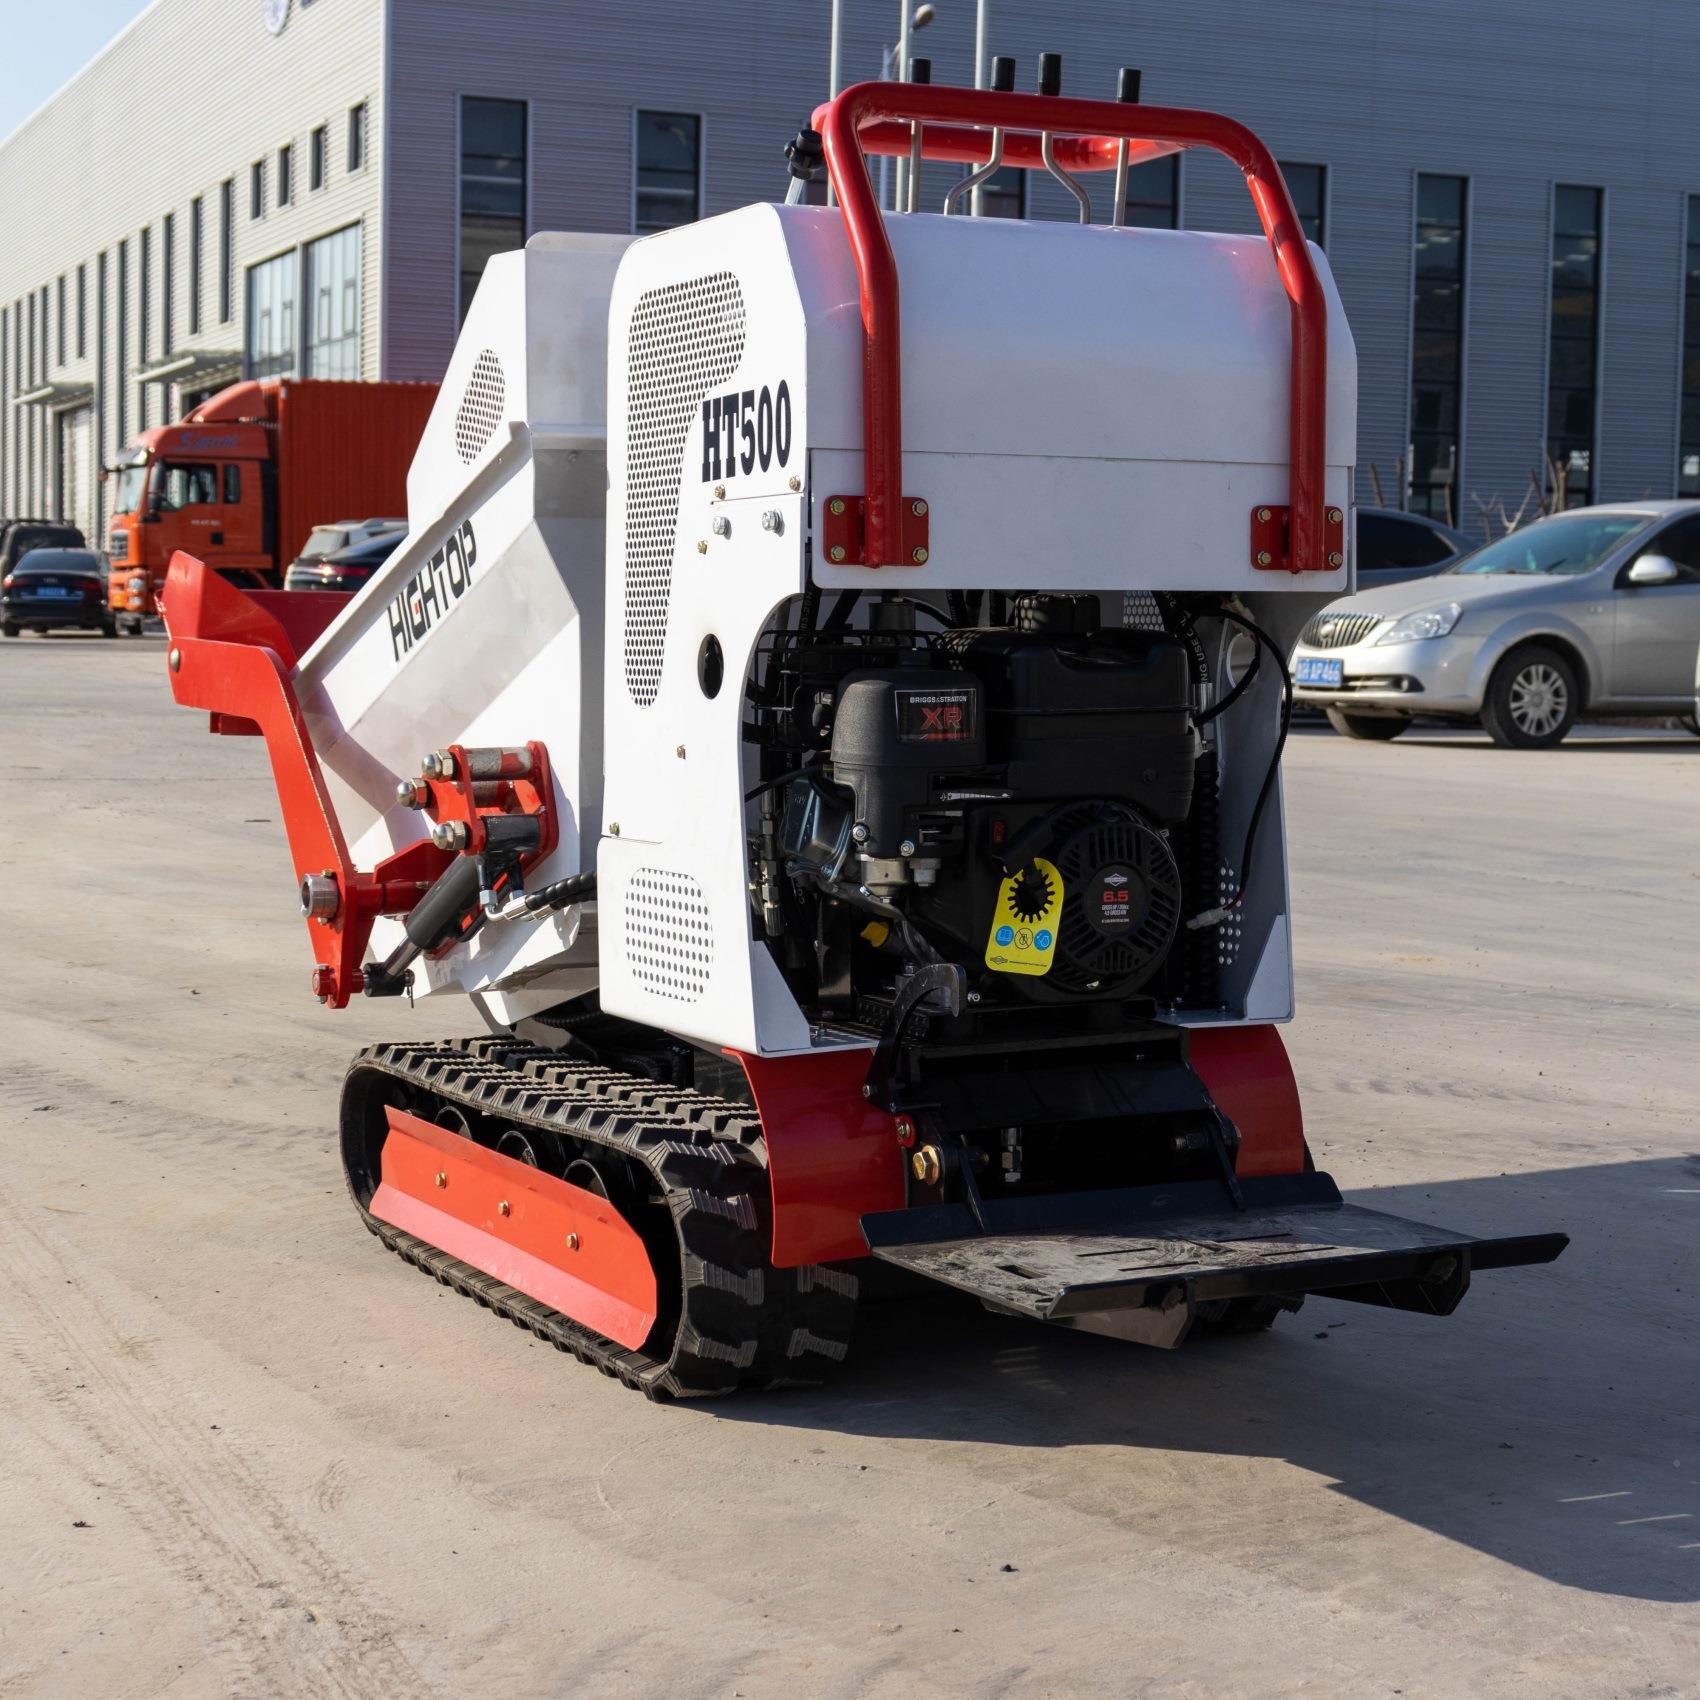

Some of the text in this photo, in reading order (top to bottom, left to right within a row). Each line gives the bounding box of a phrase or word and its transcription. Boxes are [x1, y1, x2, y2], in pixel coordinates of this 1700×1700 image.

[702, 379, 791, 483] HT500
[387, 519, 477, 662] HIGHTOP
[920, 706, 962, 730] XR
[1103, 890, 1129, 903] 6.5
